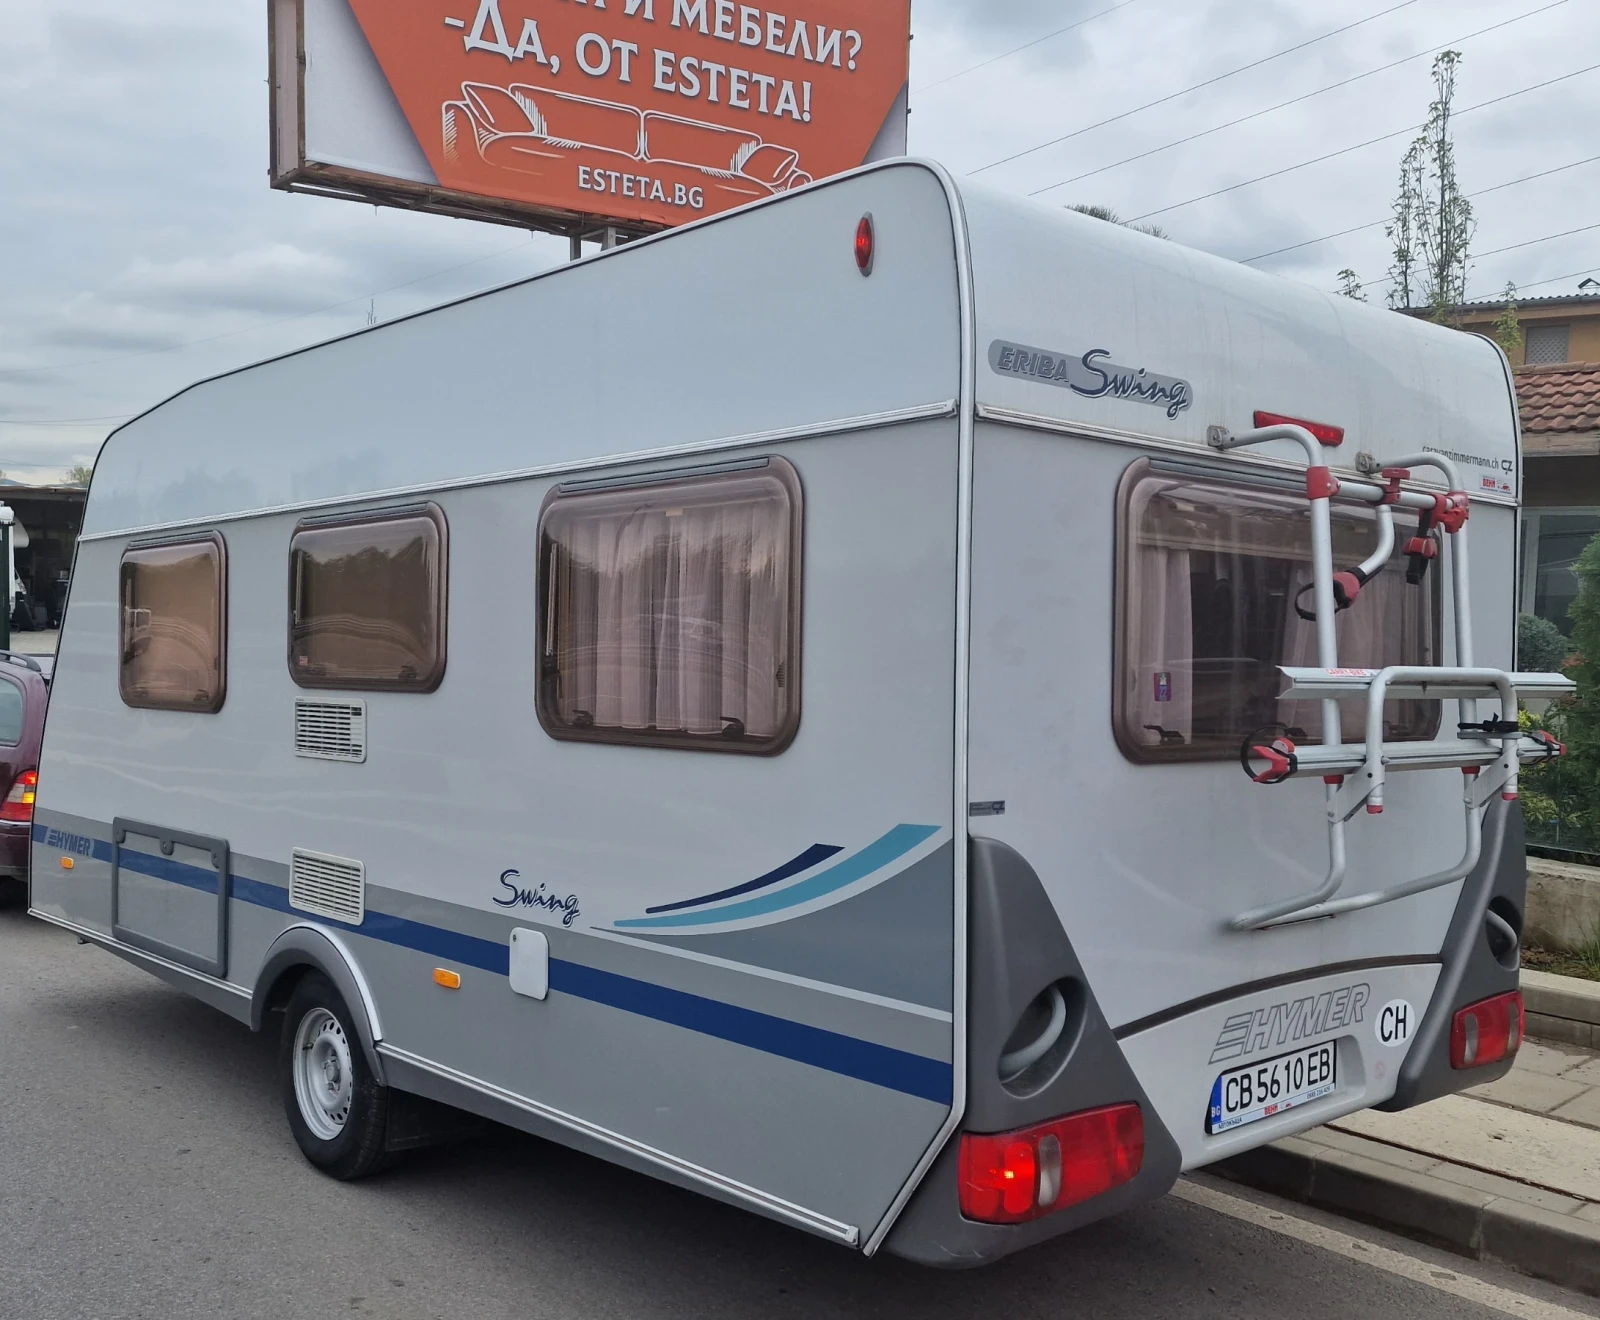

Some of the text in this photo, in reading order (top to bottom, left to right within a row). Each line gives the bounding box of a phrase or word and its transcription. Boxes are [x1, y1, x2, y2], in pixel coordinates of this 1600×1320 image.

[575, 32, 638, 82] ОТ
[671, 0, 862, 70] МЕБЕЛИ?
[653, 48, 812, 122] ESTETA!
[578, 165, 704, 209] ESTETA.BG
[998, 346, 1188, 420] ERIBA Swing
[54, 830, 91, 857] HYMER
[492, 869, 580, 928] Swing
[1238, 983, 1371, 1055] HYMER
[1380, 1004, 1407, 1043] CH
[1211, 1105, 1221, 1118] BG
